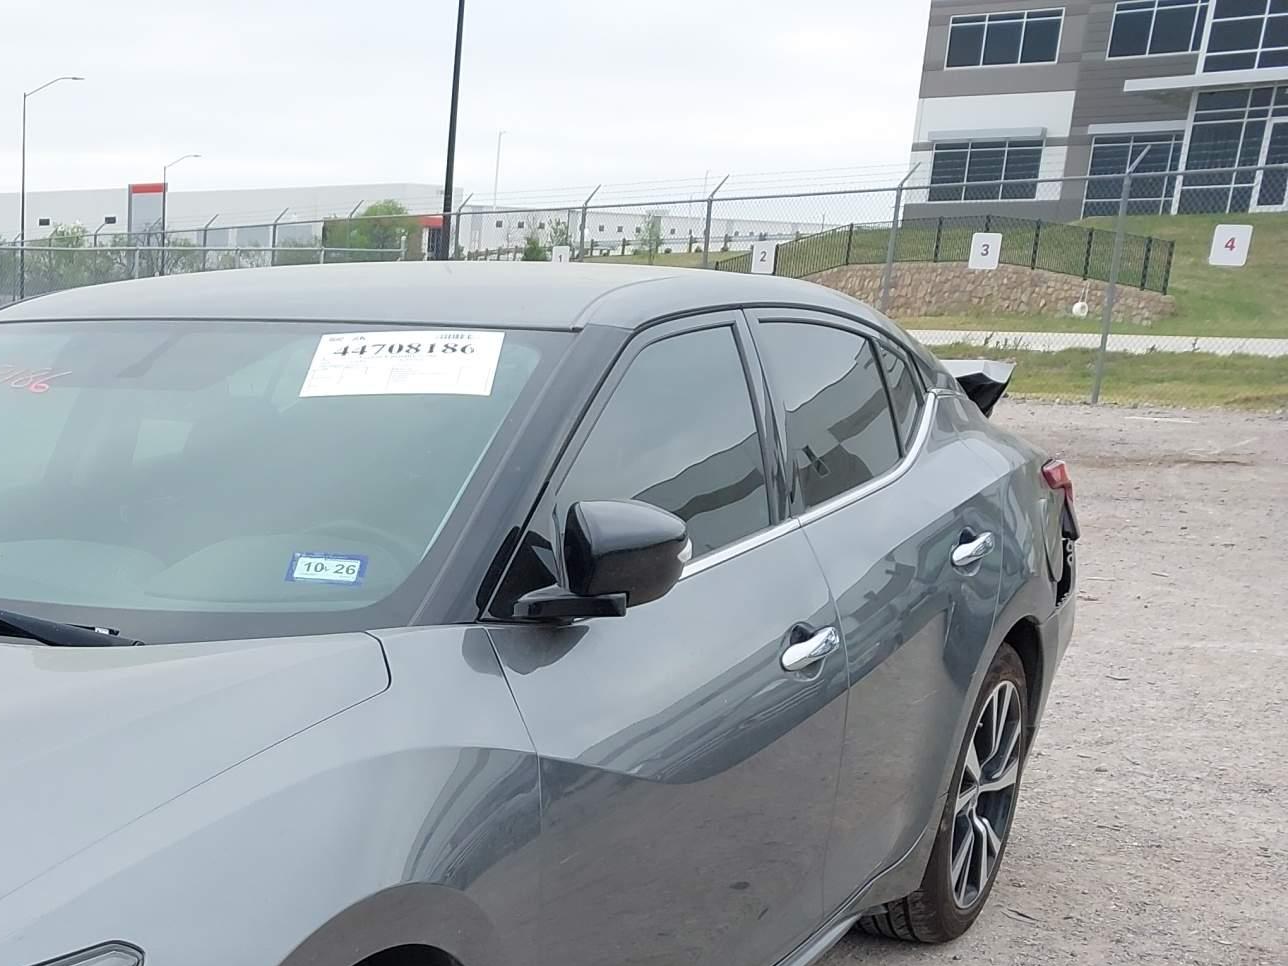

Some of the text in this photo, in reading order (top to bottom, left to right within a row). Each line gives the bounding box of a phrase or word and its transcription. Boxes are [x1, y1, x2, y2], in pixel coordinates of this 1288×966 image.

[980, 243, 990, 256] 3
[1224, 237, 1236, 251] 4
[759, 250, 767, 262] 2
[333, 342, 475, 357] 44708186
[303, 562, 357, 575] 10 26
